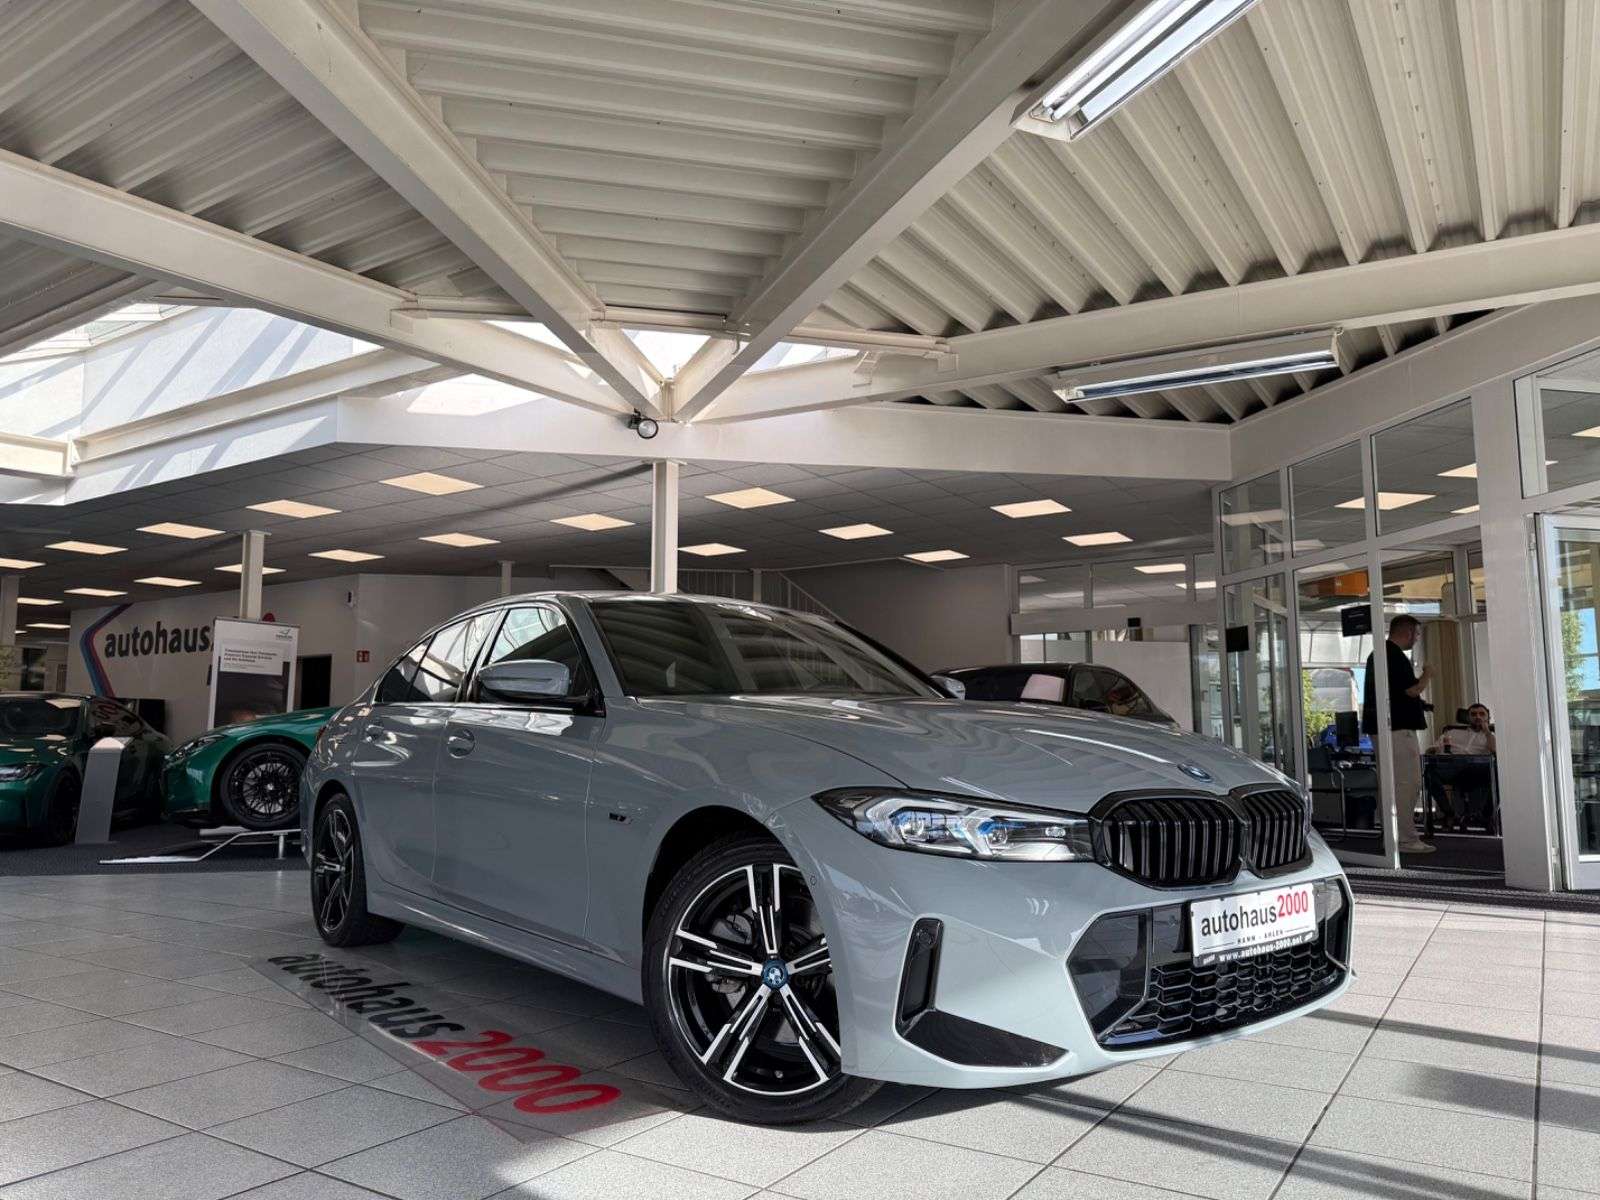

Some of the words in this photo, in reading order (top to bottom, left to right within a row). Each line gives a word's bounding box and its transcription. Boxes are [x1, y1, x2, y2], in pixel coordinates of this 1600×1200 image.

[104, 621, 214, 658] autohaus
[1201, 890, 1309, 937] autohaus2000
[267, 953, 622, 1115] autohaus2000
